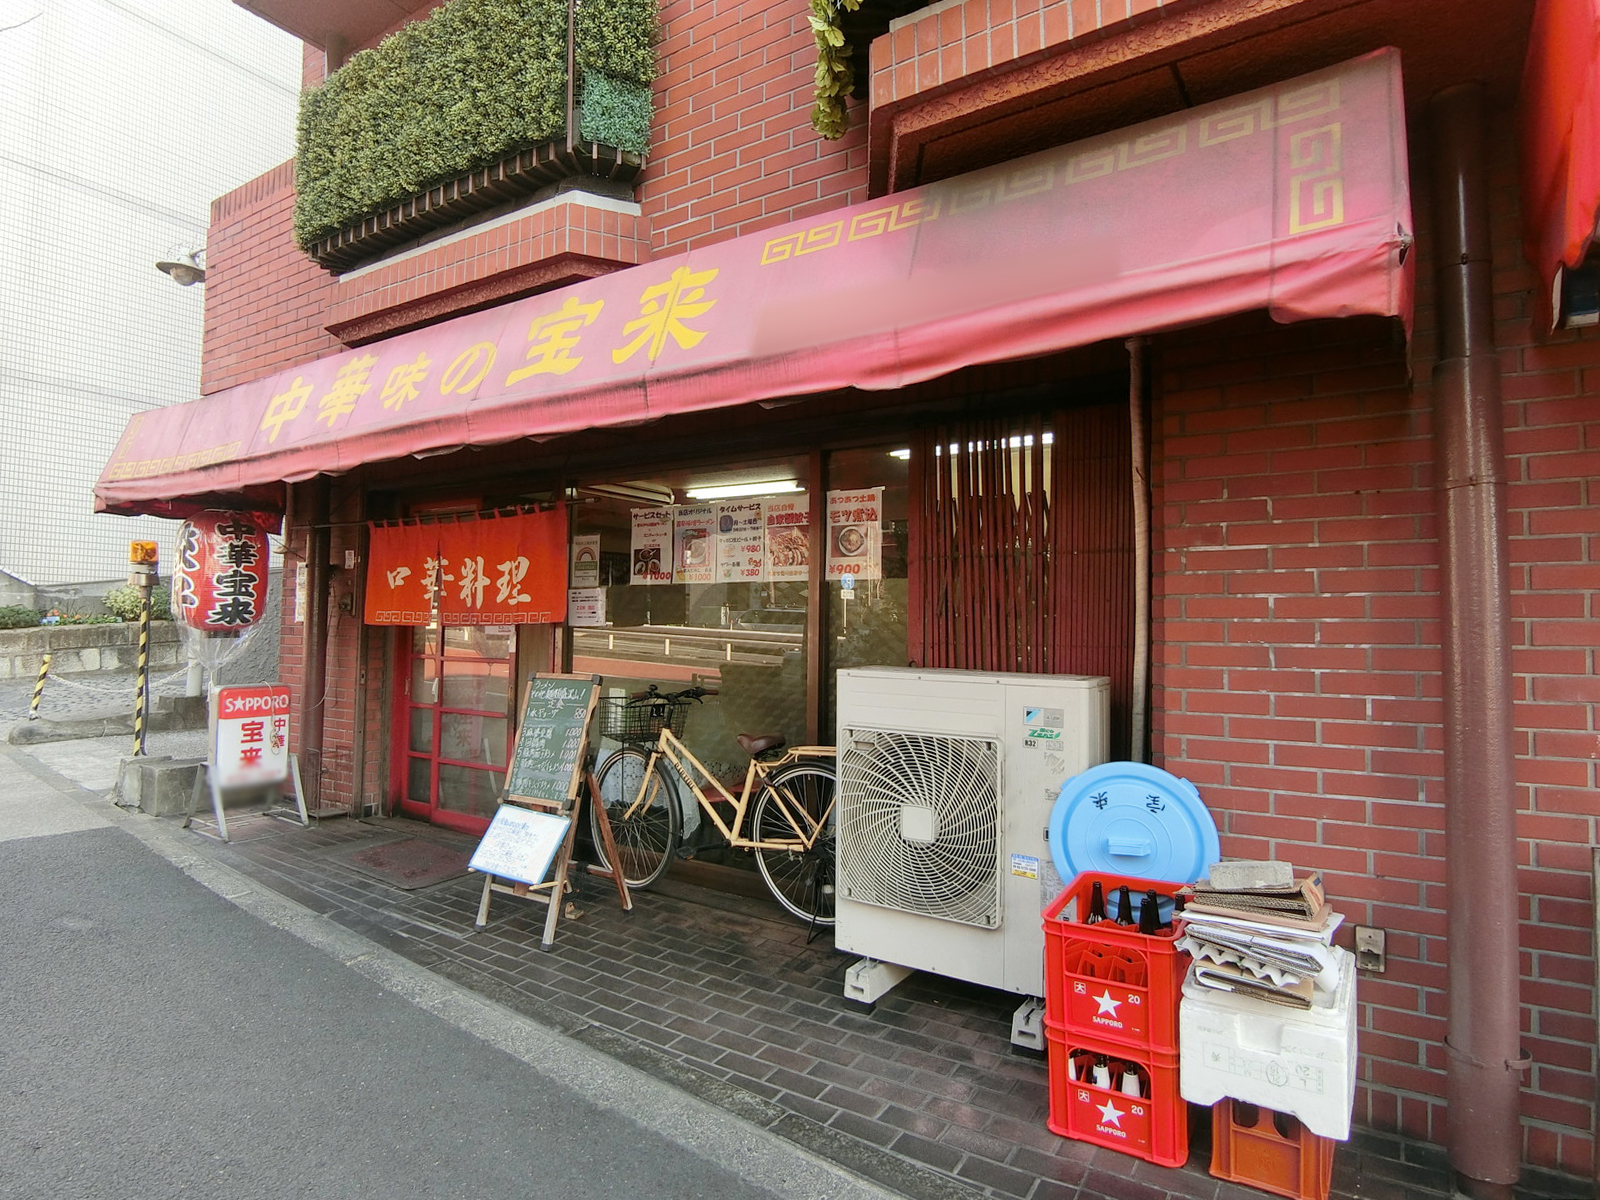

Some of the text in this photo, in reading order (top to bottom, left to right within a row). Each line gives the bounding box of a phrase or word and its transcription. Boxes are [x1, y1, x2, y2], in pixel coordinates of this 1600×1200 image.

[259, 265, 720, 445] 中華味の宝来
[719, 503, 761, 514] タイムサービス
[633, 510, 671, 520] サービスセット
[829, 507, 878, 523] モツ煮込
[205, 518, 259, 626] 中華宝来
[828, 563, 861, 575] ¥900
[574, 707, 587, 719] 850
[1128, 993, 1141, 1005] 20
[1092, 1015, 1124, 1029] SAPPORO
[1131, 1105, 1144, 1116] 20
[1096, 1124, 1127, 1138] SAPPORO
